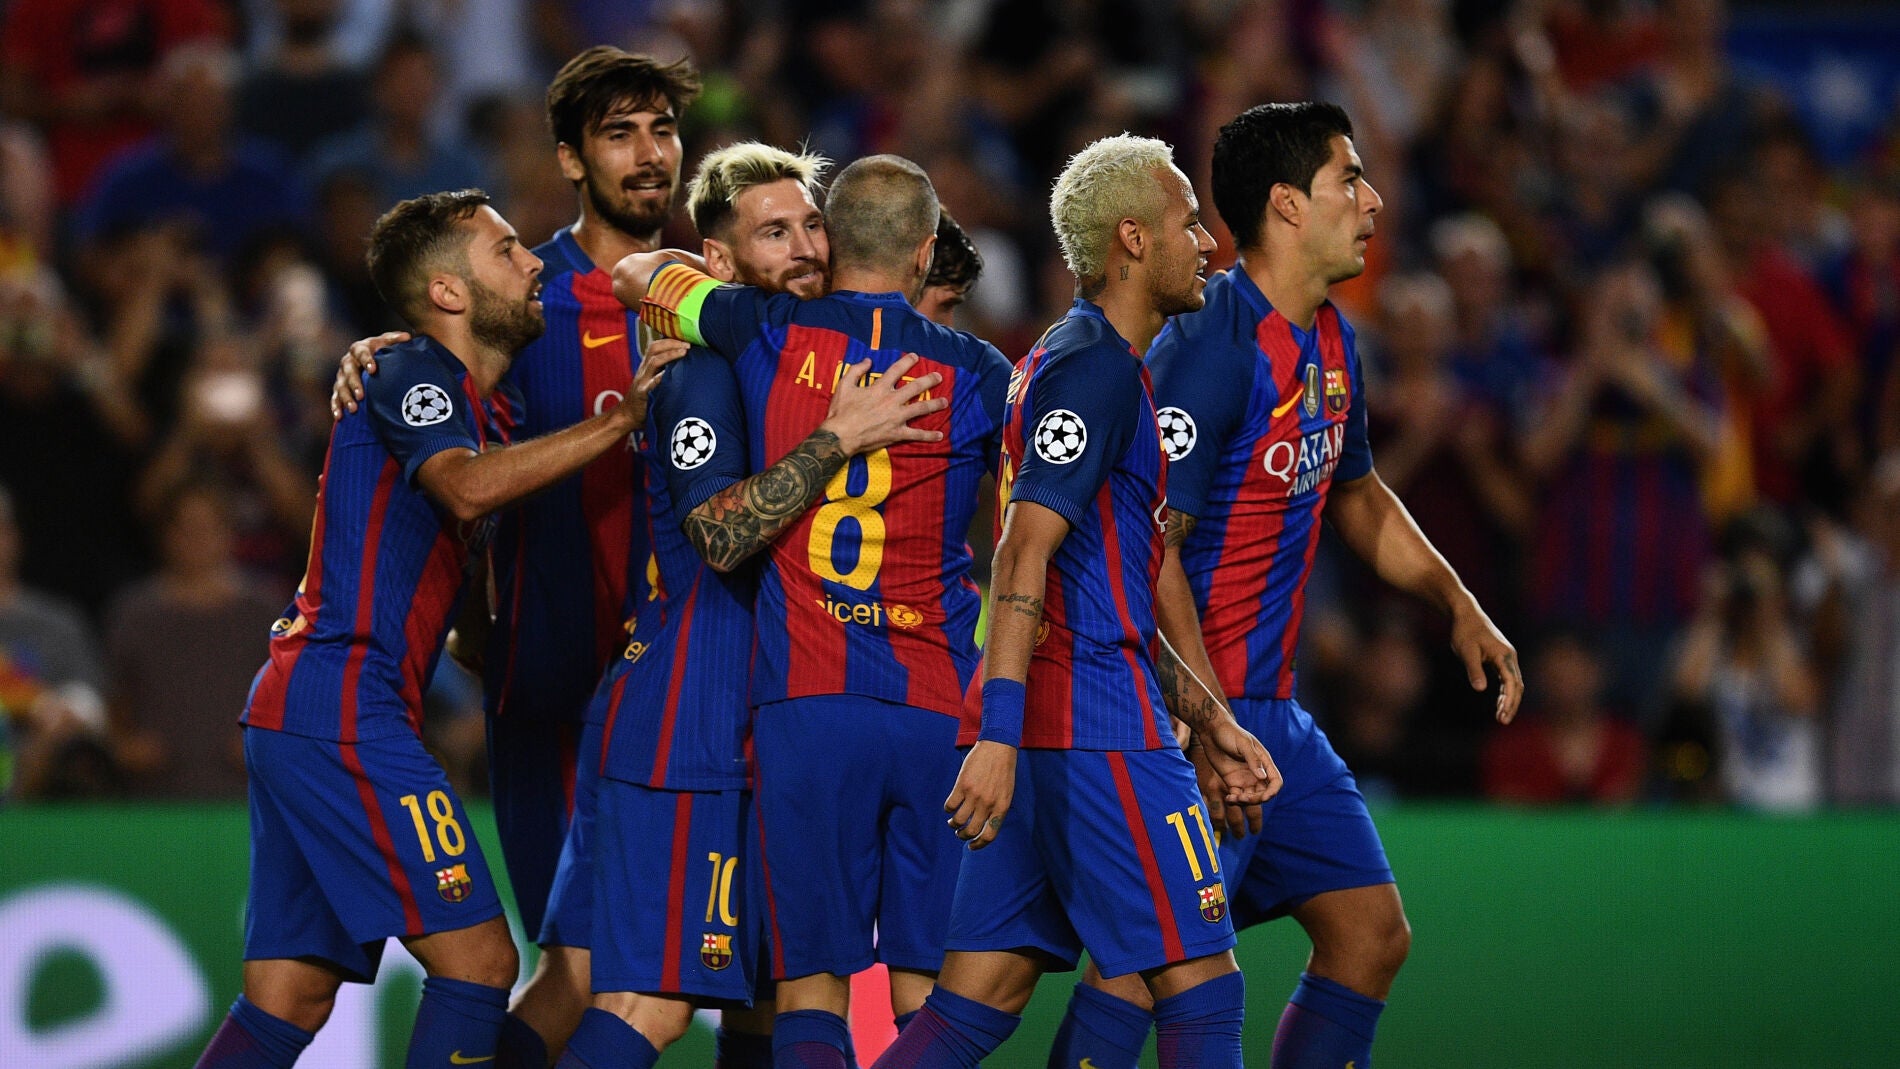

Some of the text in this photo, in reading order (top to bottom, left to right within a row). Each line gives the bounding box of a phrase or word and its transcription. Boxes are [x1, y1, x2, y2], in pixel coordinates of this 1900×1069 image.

[794, 351, 823, 390] A.
[1263, 422, 1344, 483] QATAR
[1286, 461, 1339, 498] AIRWAY
[807, 448, 893, 591] 8
[399, 789, 467, 864] 18
[1165, 803, 1220, 882] 11
[704, 851, 740, 927] 10
